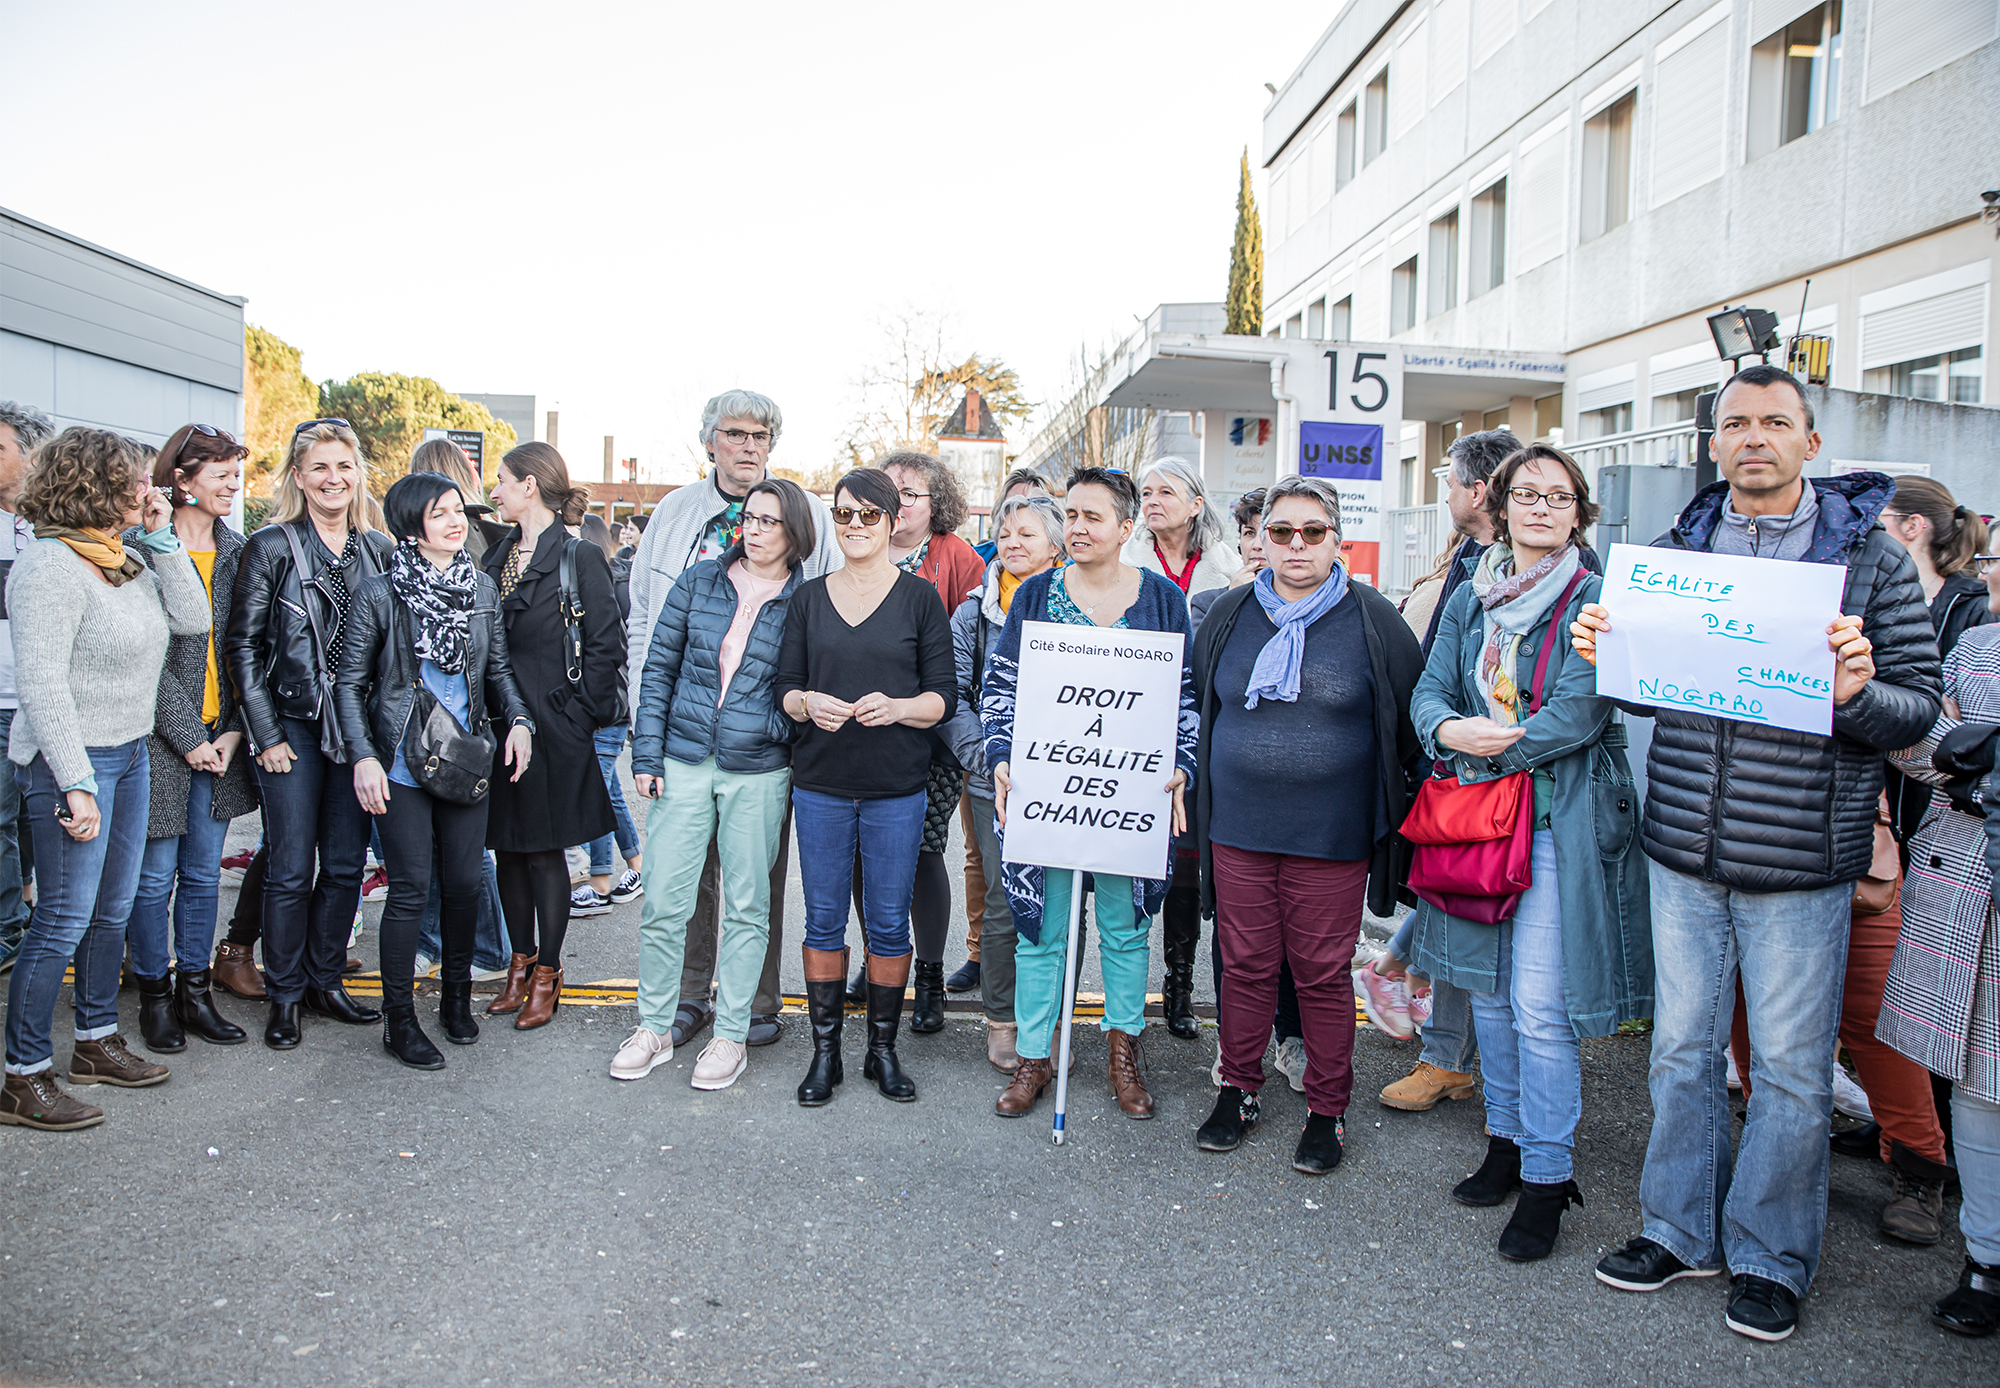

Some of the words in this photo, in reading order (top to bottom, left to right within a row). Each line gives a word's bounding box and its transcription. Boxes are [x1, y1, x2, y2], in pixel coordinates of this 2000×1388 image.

[1403, 354, 1445, 367] Liberté
[1508, 360, 1566, 374] Fraternité
[1323, 350, 1389, 412] 15
[1235, 449, 1266, 459] Liberté
[1305, 464, 1318, 473] 32
[1341, 505, 1379, 514] MENTAL
[1701, 612, 1756, 636] DES
[1029, 639, 1055, 652] Cité
[1058, 641, 1110, 657] Scolaire
[1113, 646, 1174, 663] NOGARO
[1737, 666, 1831, 693] CHANCES
[1056, 685, 1143, 711] DROIT
[1638, 678, 1764, 715] NOGARO
[1084, 713, 1103, 738] À
[1063, 775, 1119, 798] DES
[1023, 801, 1156, 833] CHANCES
